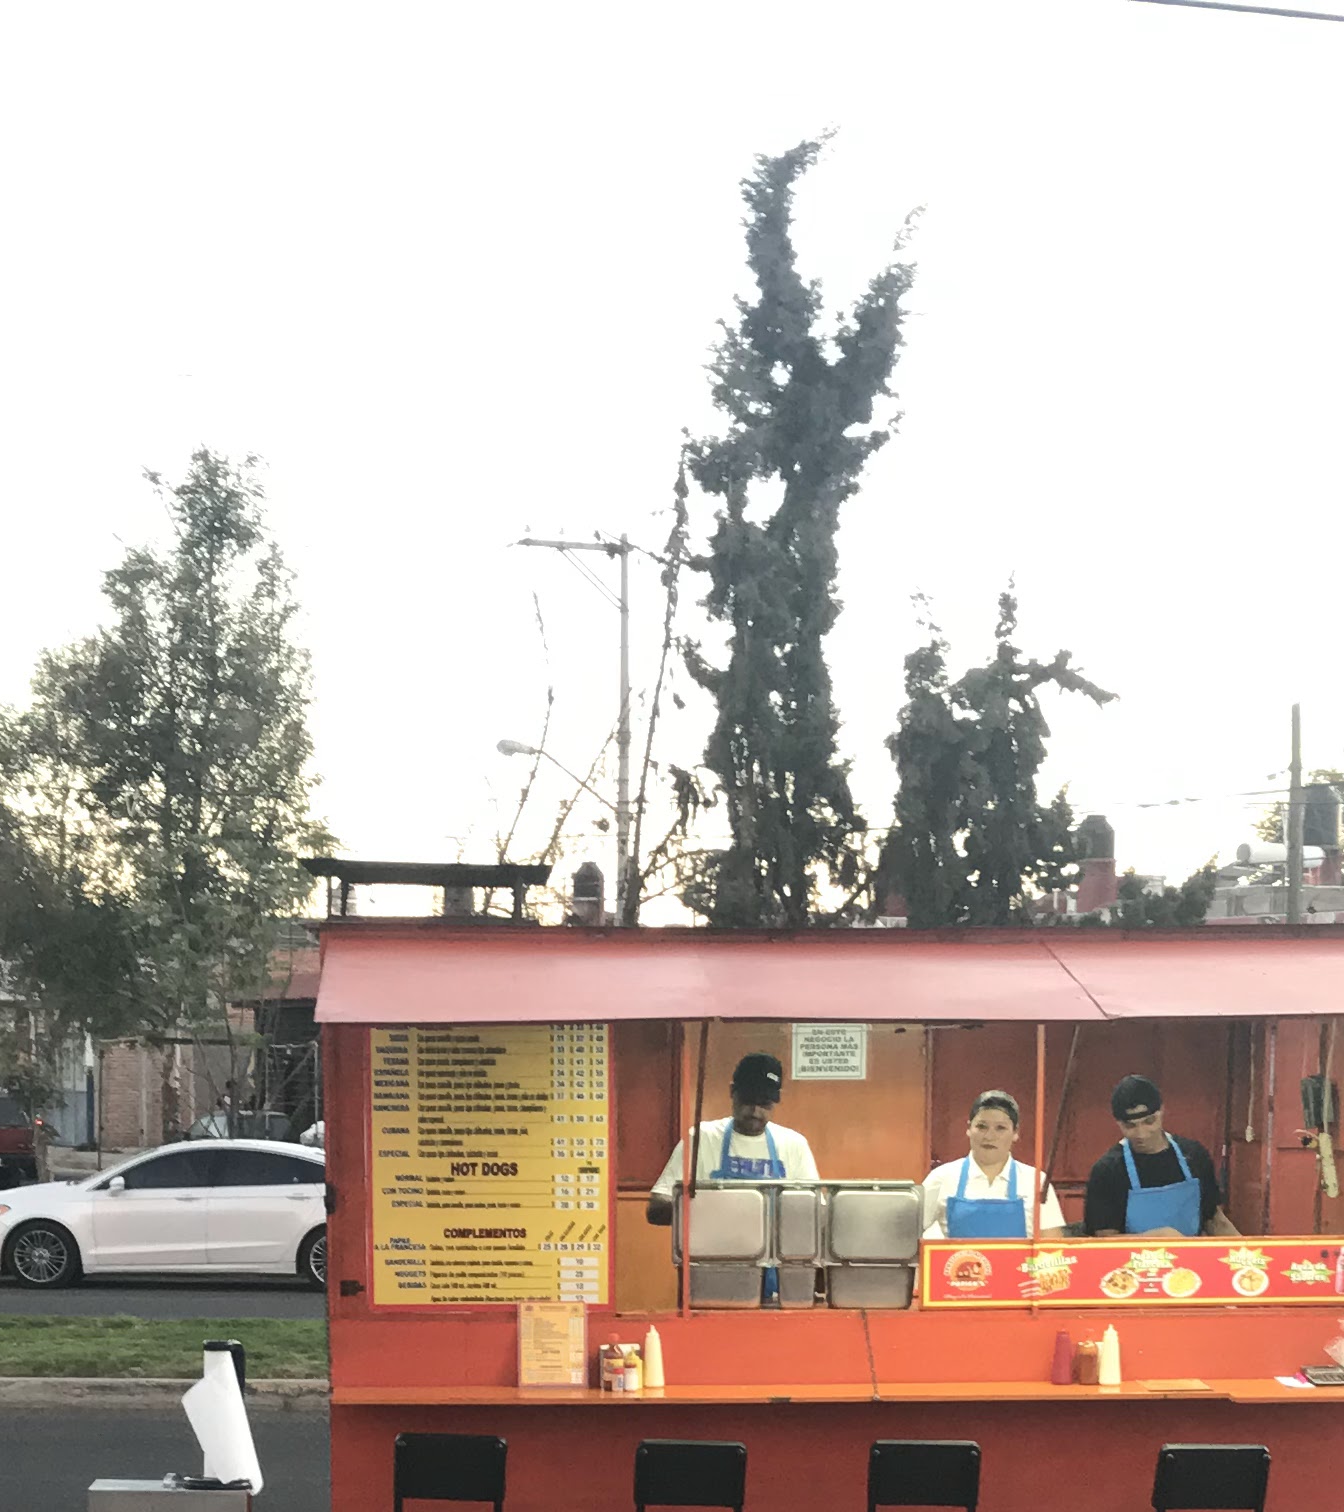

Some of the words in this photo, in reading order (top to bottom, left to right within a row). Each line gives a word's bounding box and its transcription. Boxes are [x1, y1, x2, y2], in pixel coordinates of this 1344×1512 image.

[450, 1162, 478, 1176] HOT
[481, 1162, 518, 1176] DOGS
[443, 1228, 527, 1239] COMPLEMENTOS
